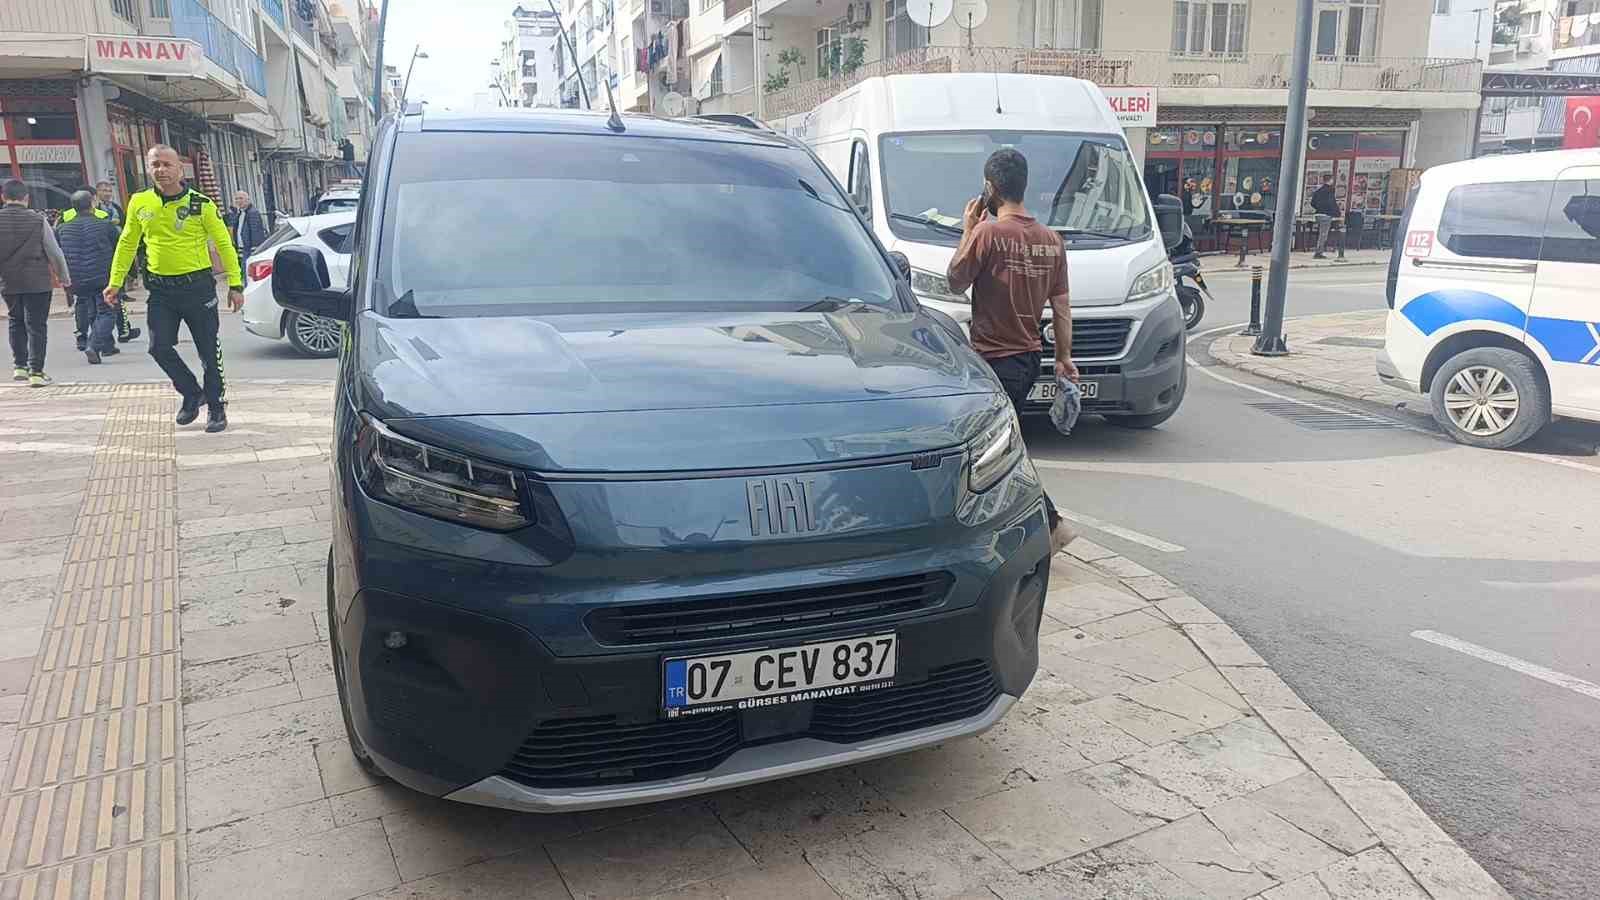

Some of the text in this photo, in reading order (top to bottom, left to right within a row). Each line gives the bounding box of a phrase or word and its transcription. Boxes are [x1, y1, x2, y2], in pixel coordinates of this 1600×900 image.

[96, 39, 185, 61] MANAV
[1108, 92, 1150, 112] KLERİ
[1411, 233, 1430, 246] 112
[745, 478, 816, 536] FIAT
[687, 639, 893, 700] 07 CEV 837
[668, 687, 684, 698] TR
[738, 694, 787, 709] GÜRSES
[791, 685, 857, 703] MANAVGAT
